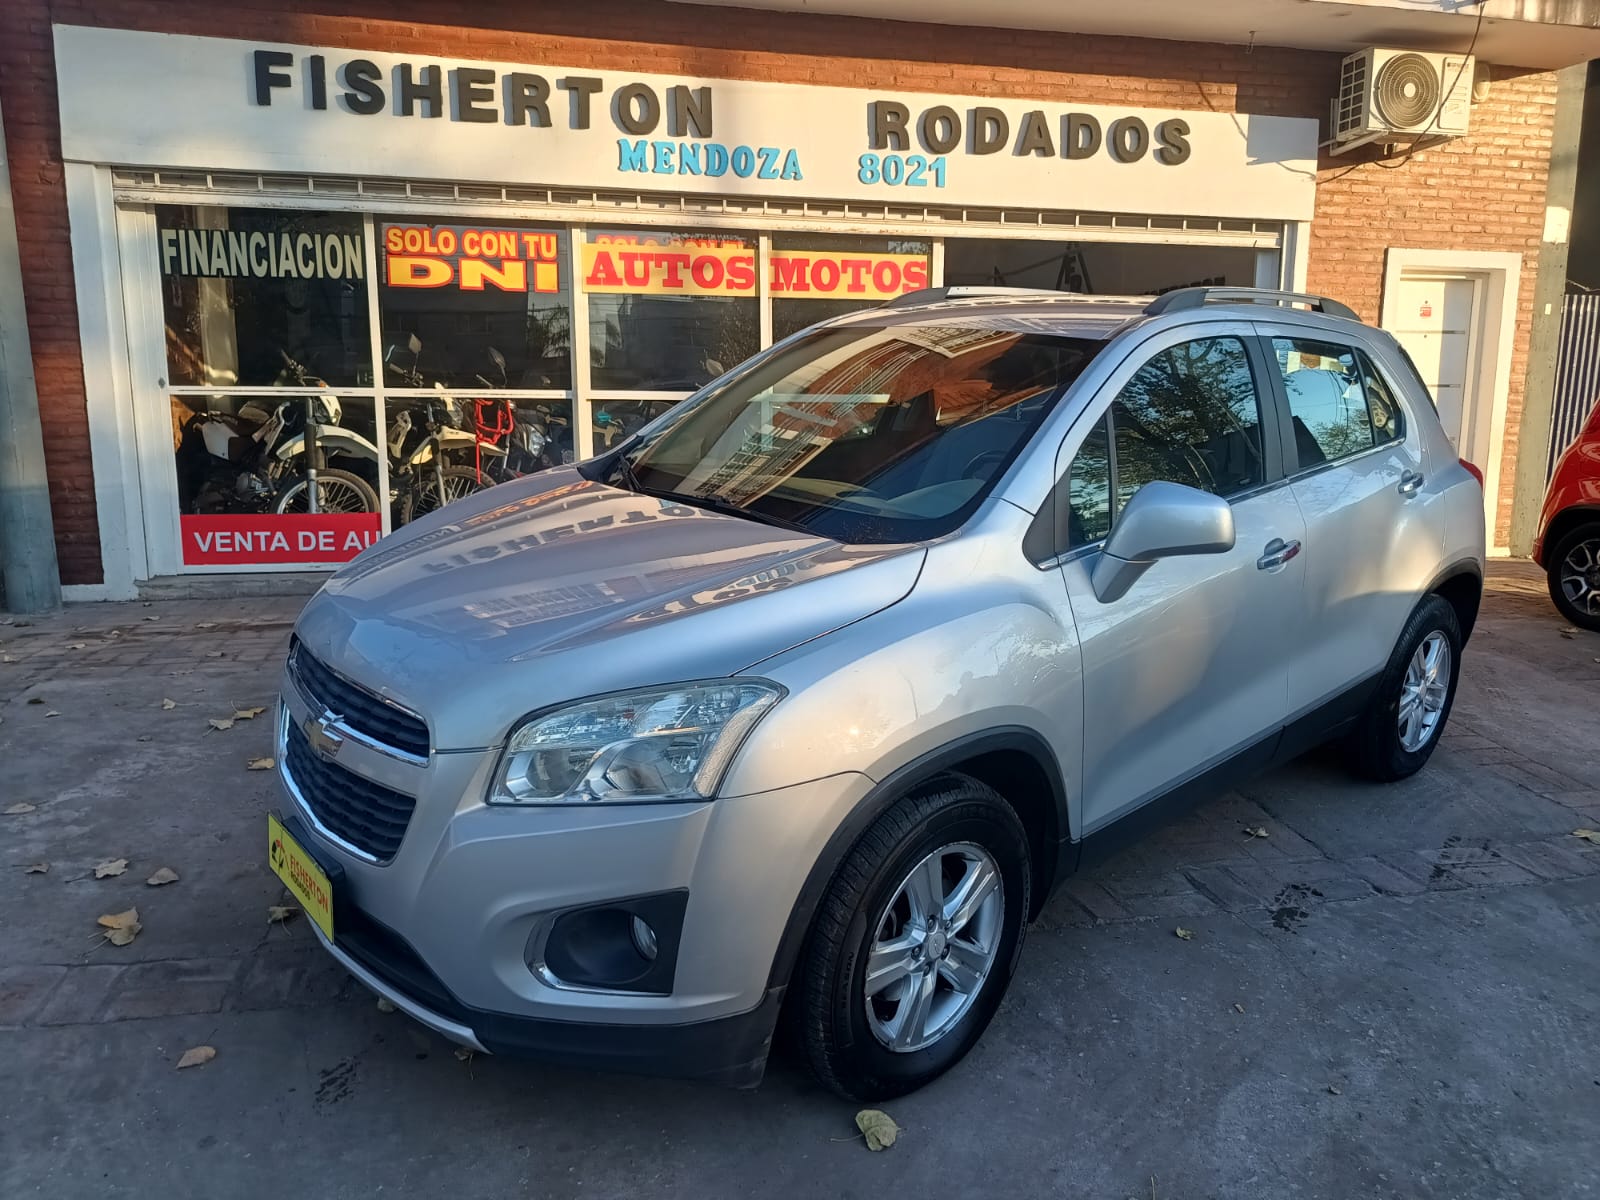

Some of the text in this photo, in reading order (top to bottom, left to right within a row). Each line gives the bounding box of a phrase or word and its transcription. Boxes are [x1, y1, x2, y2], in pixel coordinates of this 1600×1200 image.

[253, 50, 1191, 166] FISHERTON RODADOS
[617, 138, 946, 188] MENDOZA 8021
[161, 229, 364, 279] FINANCIACION
[386, 226, 559, 260] SOLO CON TU
[386, 254, 560, 293] DNI
[586, 251, 928, 294] AUTOS MOTOS
[193, 531, 290, 552] VENTA
[298, 531, 336, 551] DE
[290, 854, 329, 914] FISHERTON
